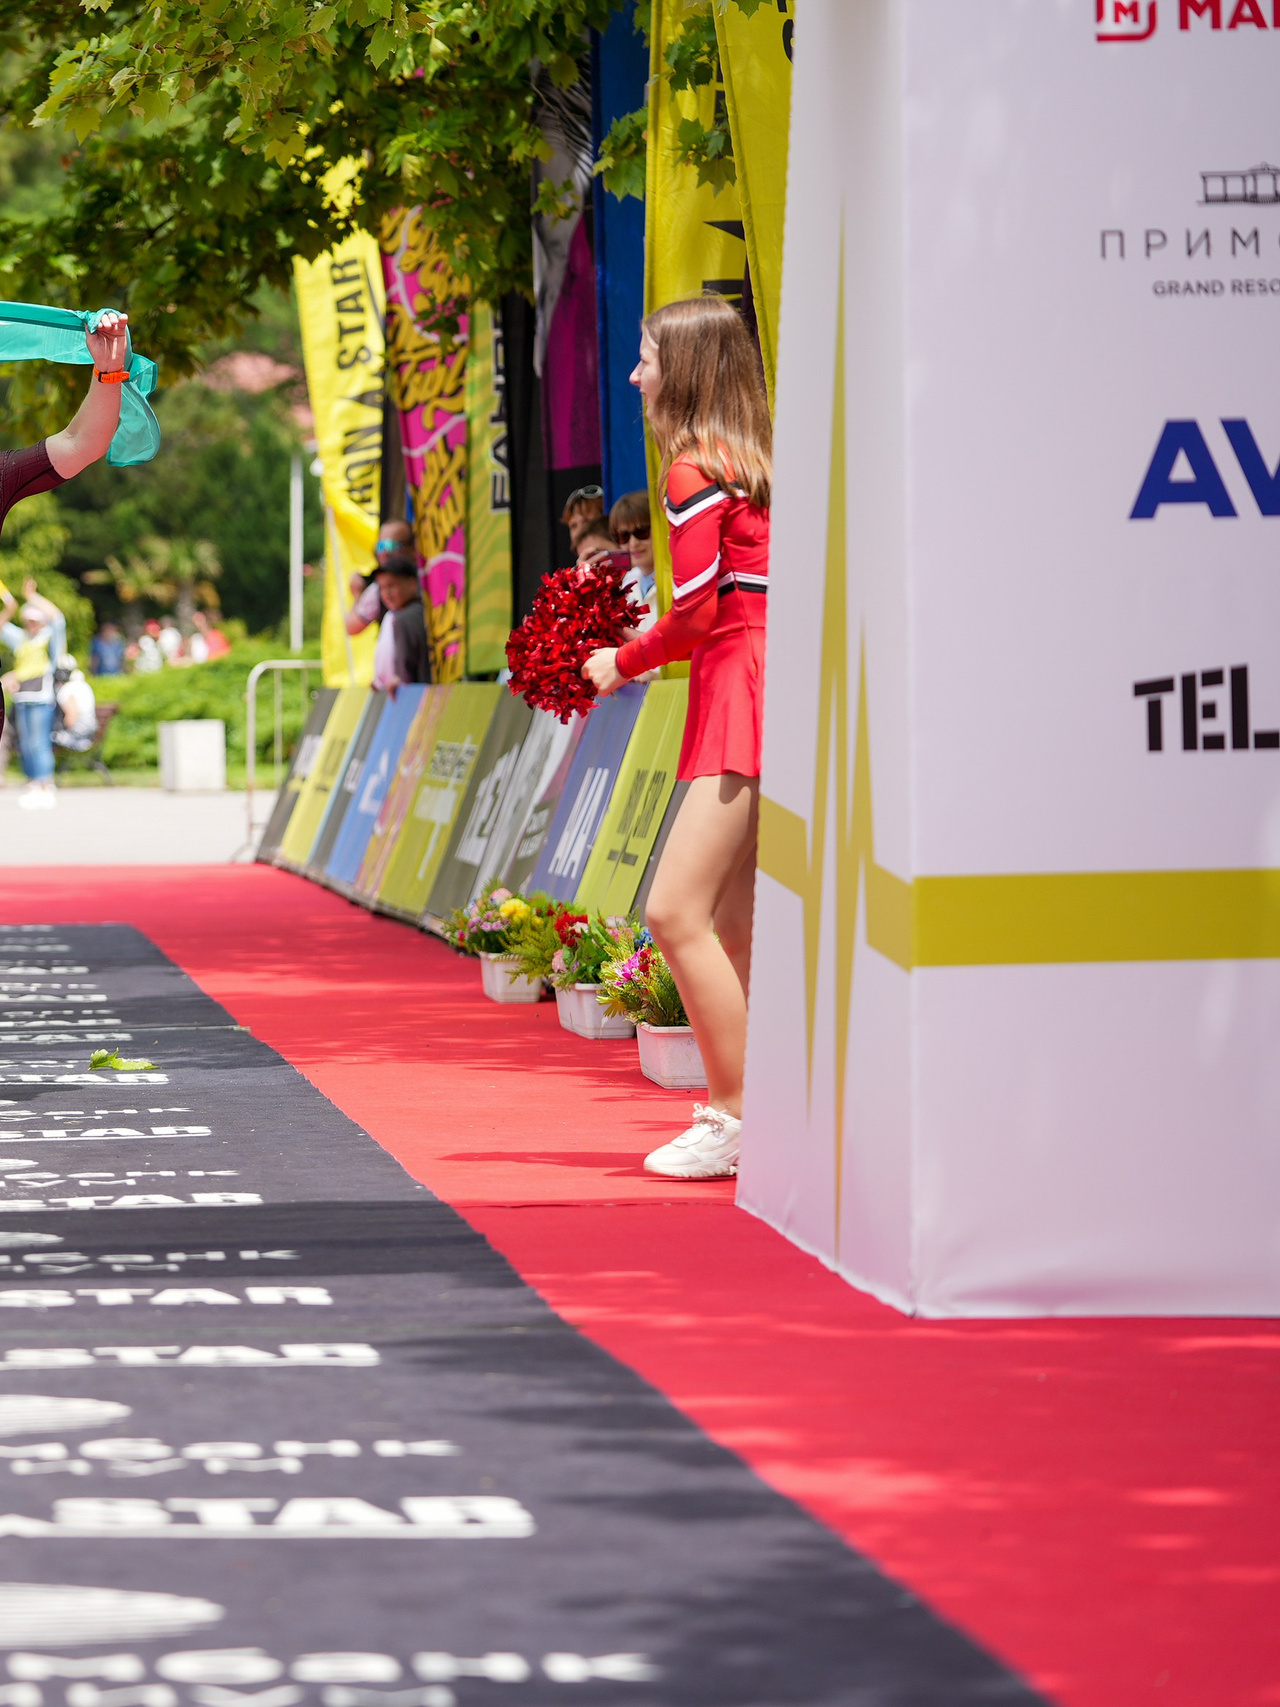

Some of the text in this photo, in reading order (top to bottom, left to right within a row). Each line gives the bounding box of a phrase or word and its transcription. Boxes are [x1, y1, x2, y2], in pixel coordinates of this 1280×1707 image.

[1100, 226, 1280, 260] ПРИМ
[1152, 280, 1225, 298] GRAND
[330, 256, 374, 372] STAR
[4, 1342, 381, 1367] STAR
[52, 1495, 535, 1537] STAR
